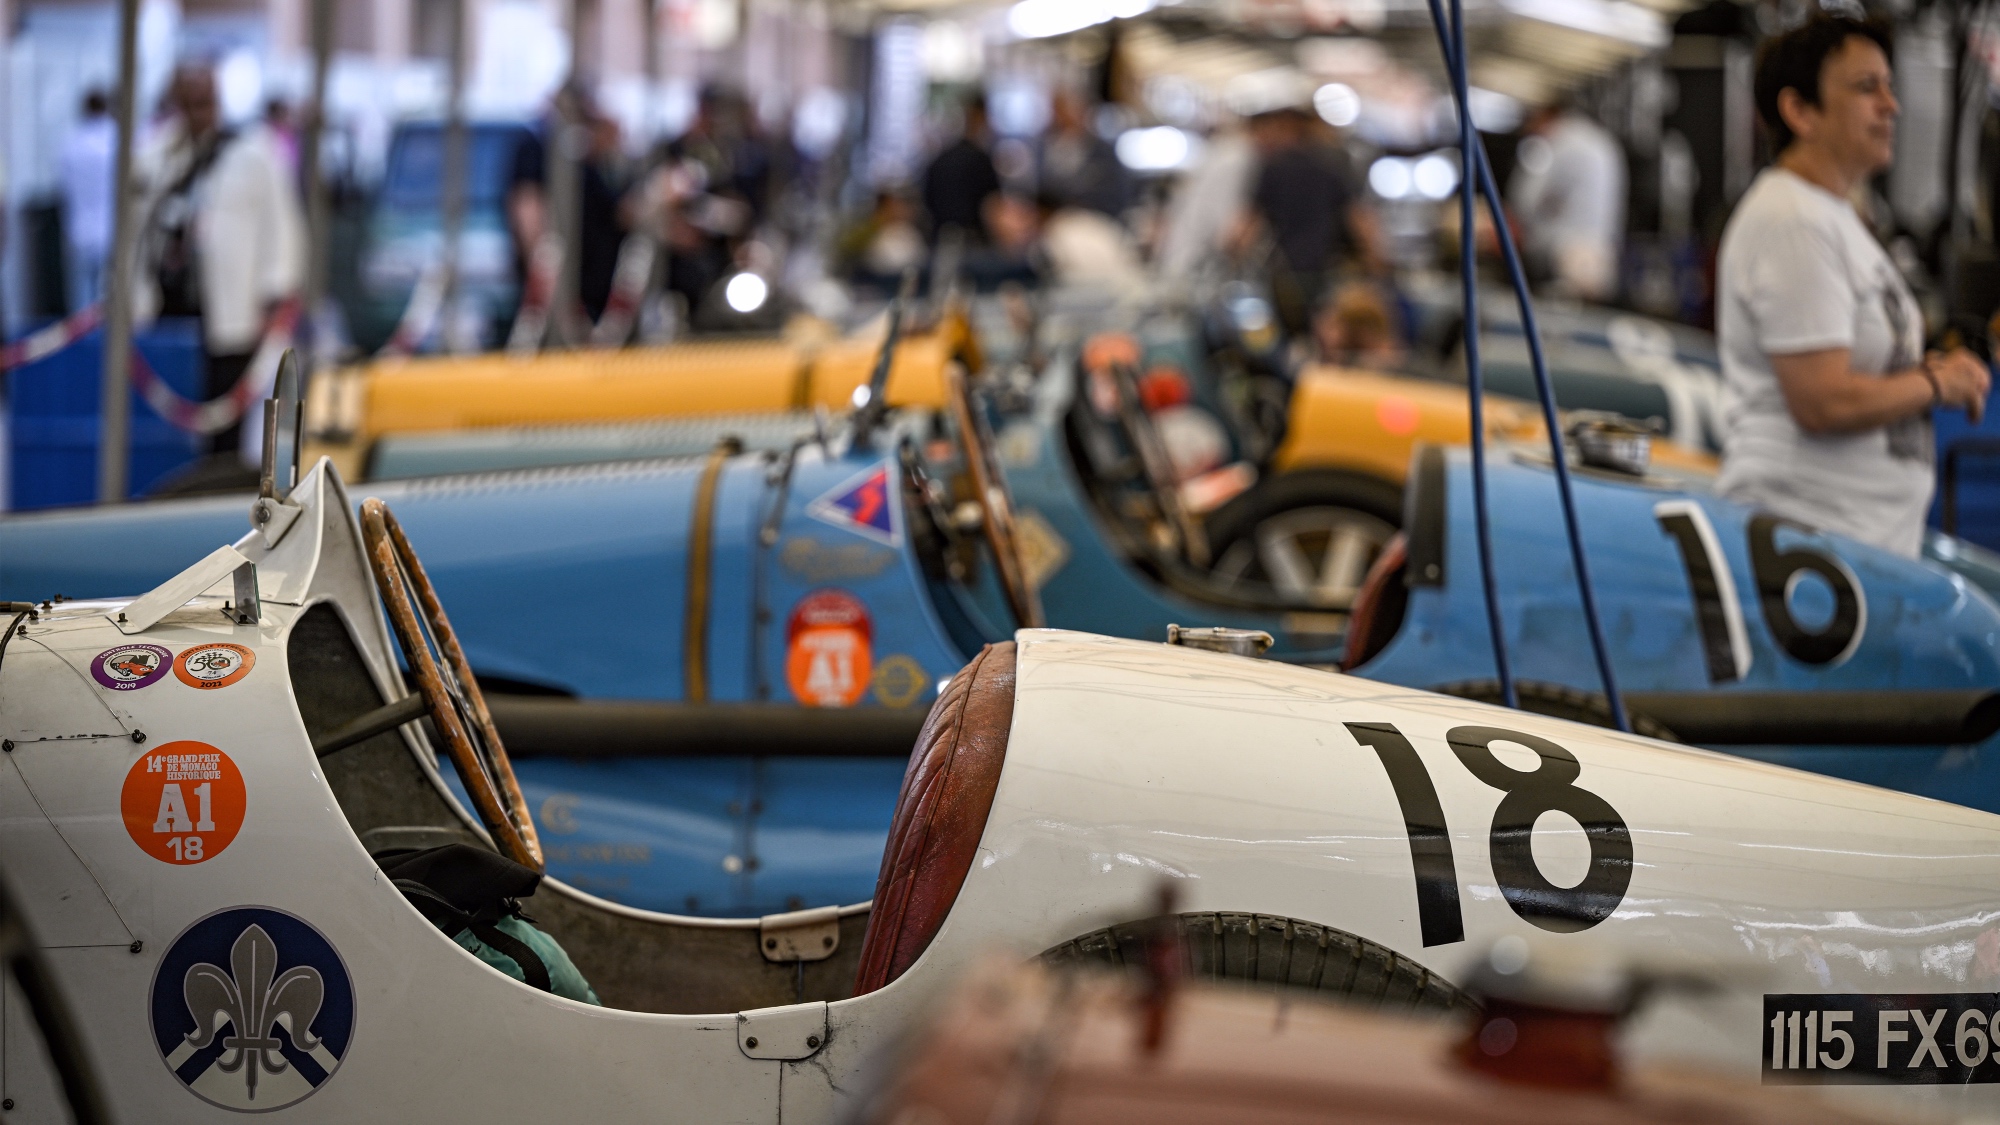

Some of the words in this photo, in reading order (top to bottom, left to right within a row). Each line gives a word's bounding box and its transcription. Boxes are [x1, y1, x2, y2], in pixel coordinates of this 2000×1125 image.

[1653, 501, 1867, 684] 16
[100, 645, 135, 659] CONTROLE
[138, 645, 169, 659] TECHNIQUE
[181, 644, 213, 659] CONTROLE
[217, 644, 250, 656] TECHNIQUE
[166, 754, 198, 763] GRAND
[199, 753, 221, 763] PRIX
[166, 763, 179, 772] DE
[179, 762, 218, 772] MONACO
[166, 770, 221, 780] HISTORIQUE
[153, 782, 216, 833] A1
[1342, 722, 1633, 948] 18
[166, 836, 204, 860] 18
[1770, 1010, 1855, 1070] 1115
[1877, 1008, 1949, 1069] FX
